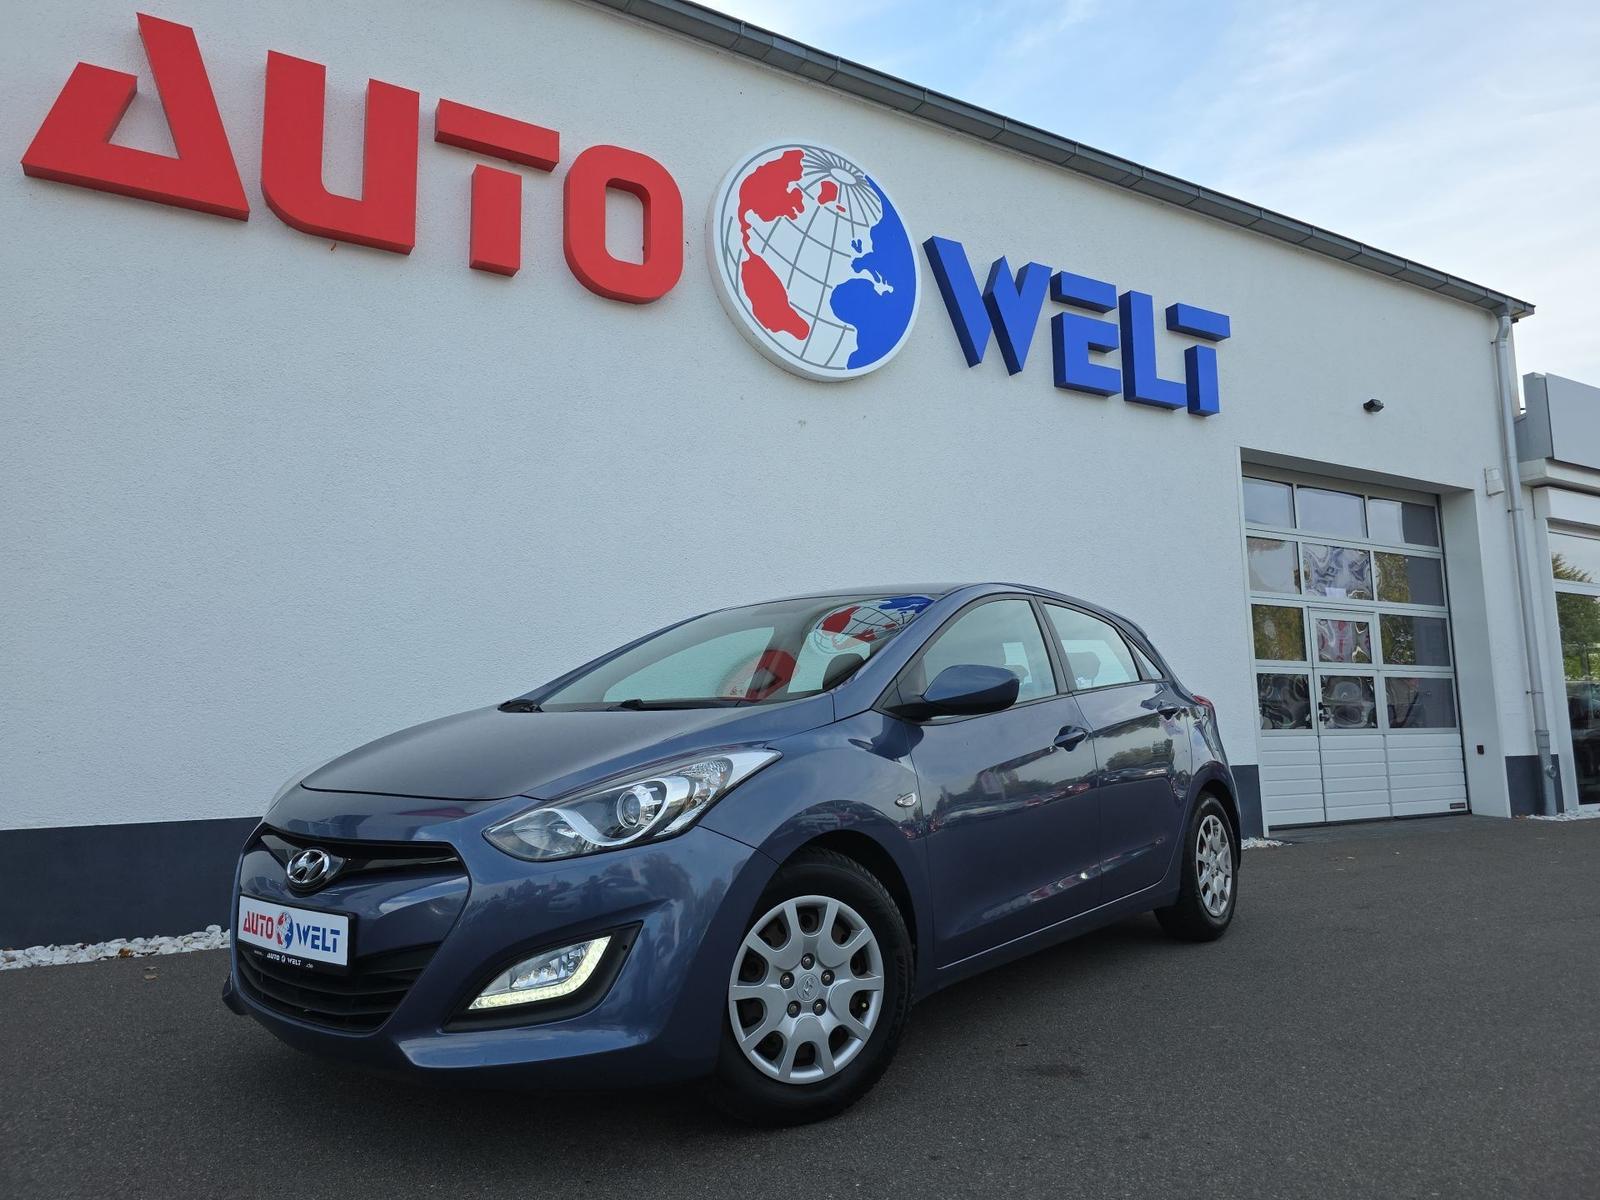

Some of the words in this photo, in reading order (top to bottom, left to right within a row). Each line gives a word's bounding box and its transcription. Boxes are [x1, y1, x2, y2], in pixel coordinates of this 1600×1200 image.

[21, 12, 684, 304] AUTO
[922, 235, 1231, 417] WELT
[243, 911, 274, 939] AUTO
[296, 923, 341, 953] WELT
